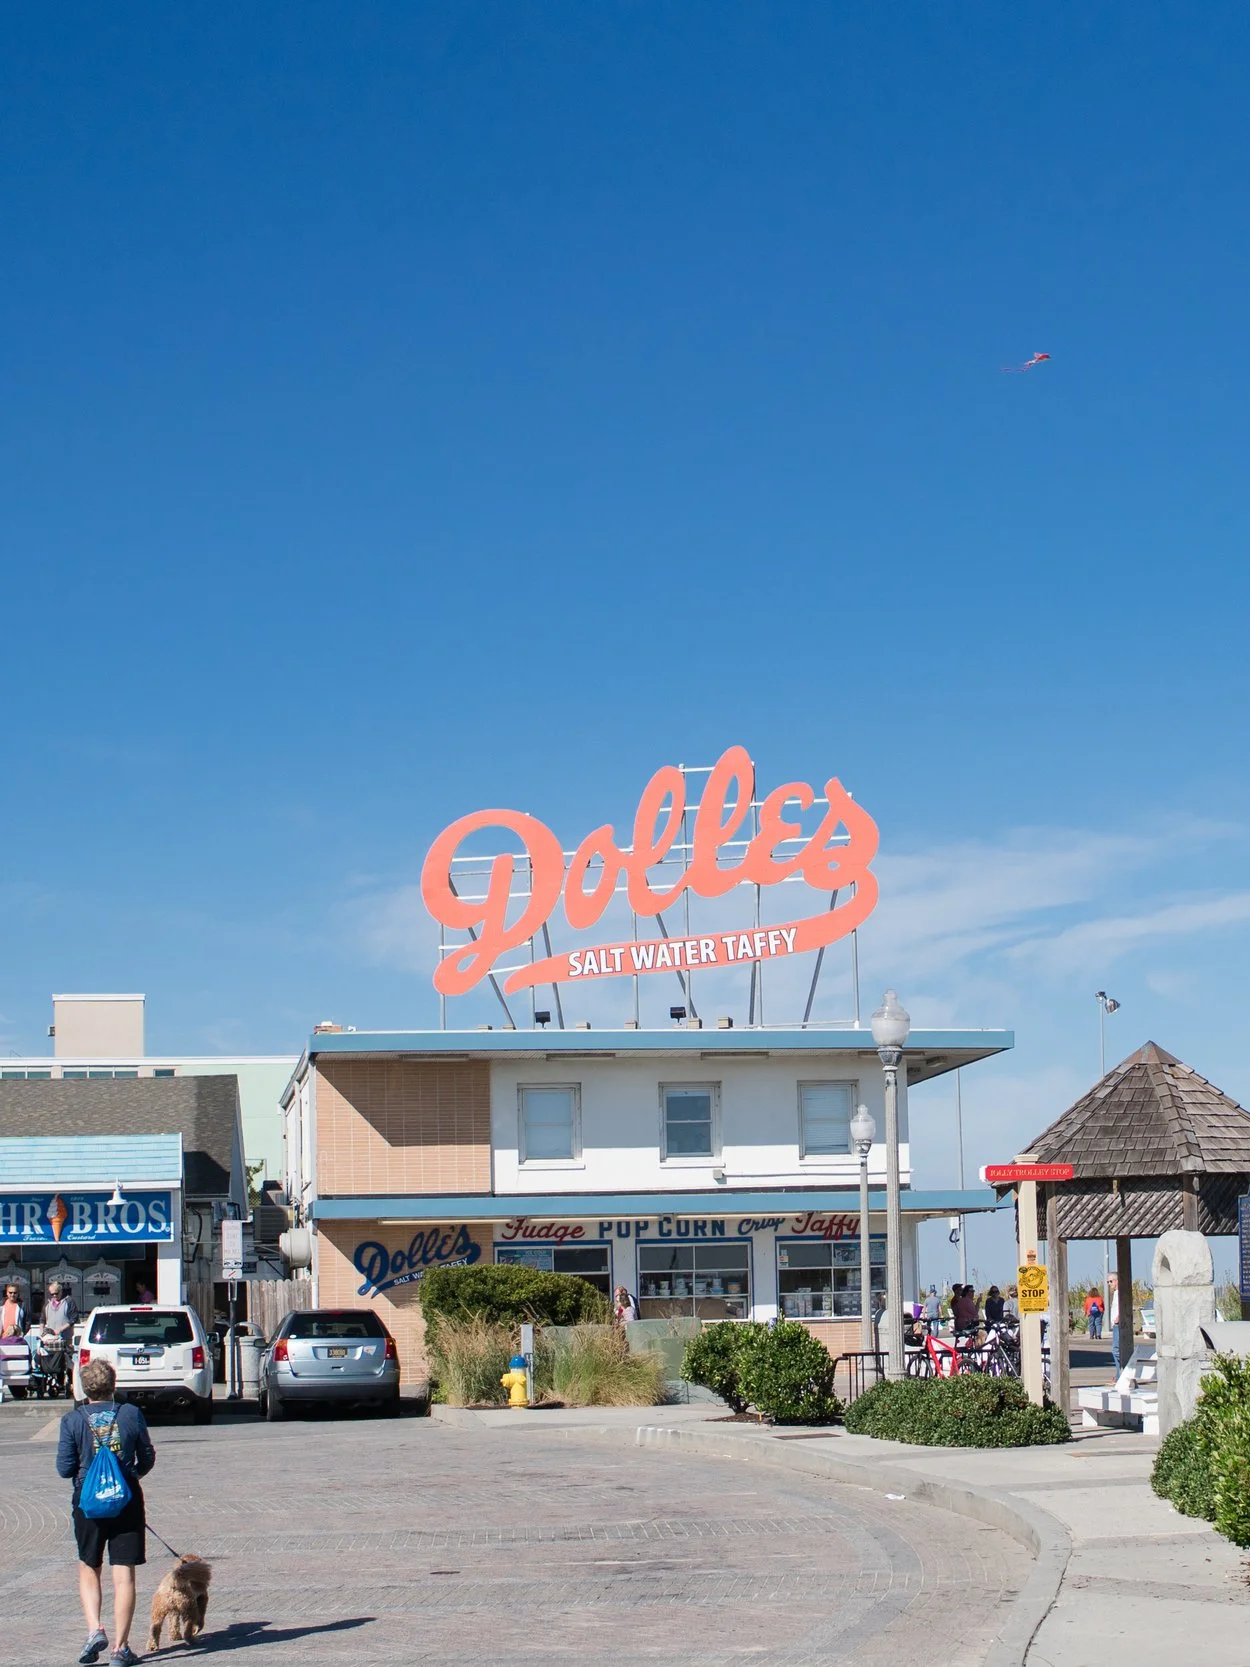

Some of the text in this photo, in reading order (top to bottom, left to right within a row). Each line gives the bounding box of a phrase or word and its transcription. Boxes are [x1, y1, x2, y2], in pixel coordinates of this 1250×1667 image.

[568, 927, 797, 977] SALT WATER TAFFY
[990, 1168, 1070, 1177] JOLLY TROLLEY STOP
[501, 1212, 861, 1246] Fudge POP CORN Crisp Taffy
[394, 1275, 410, 1286] SALT
[1021, 1289, 1045, 1298] STOP
